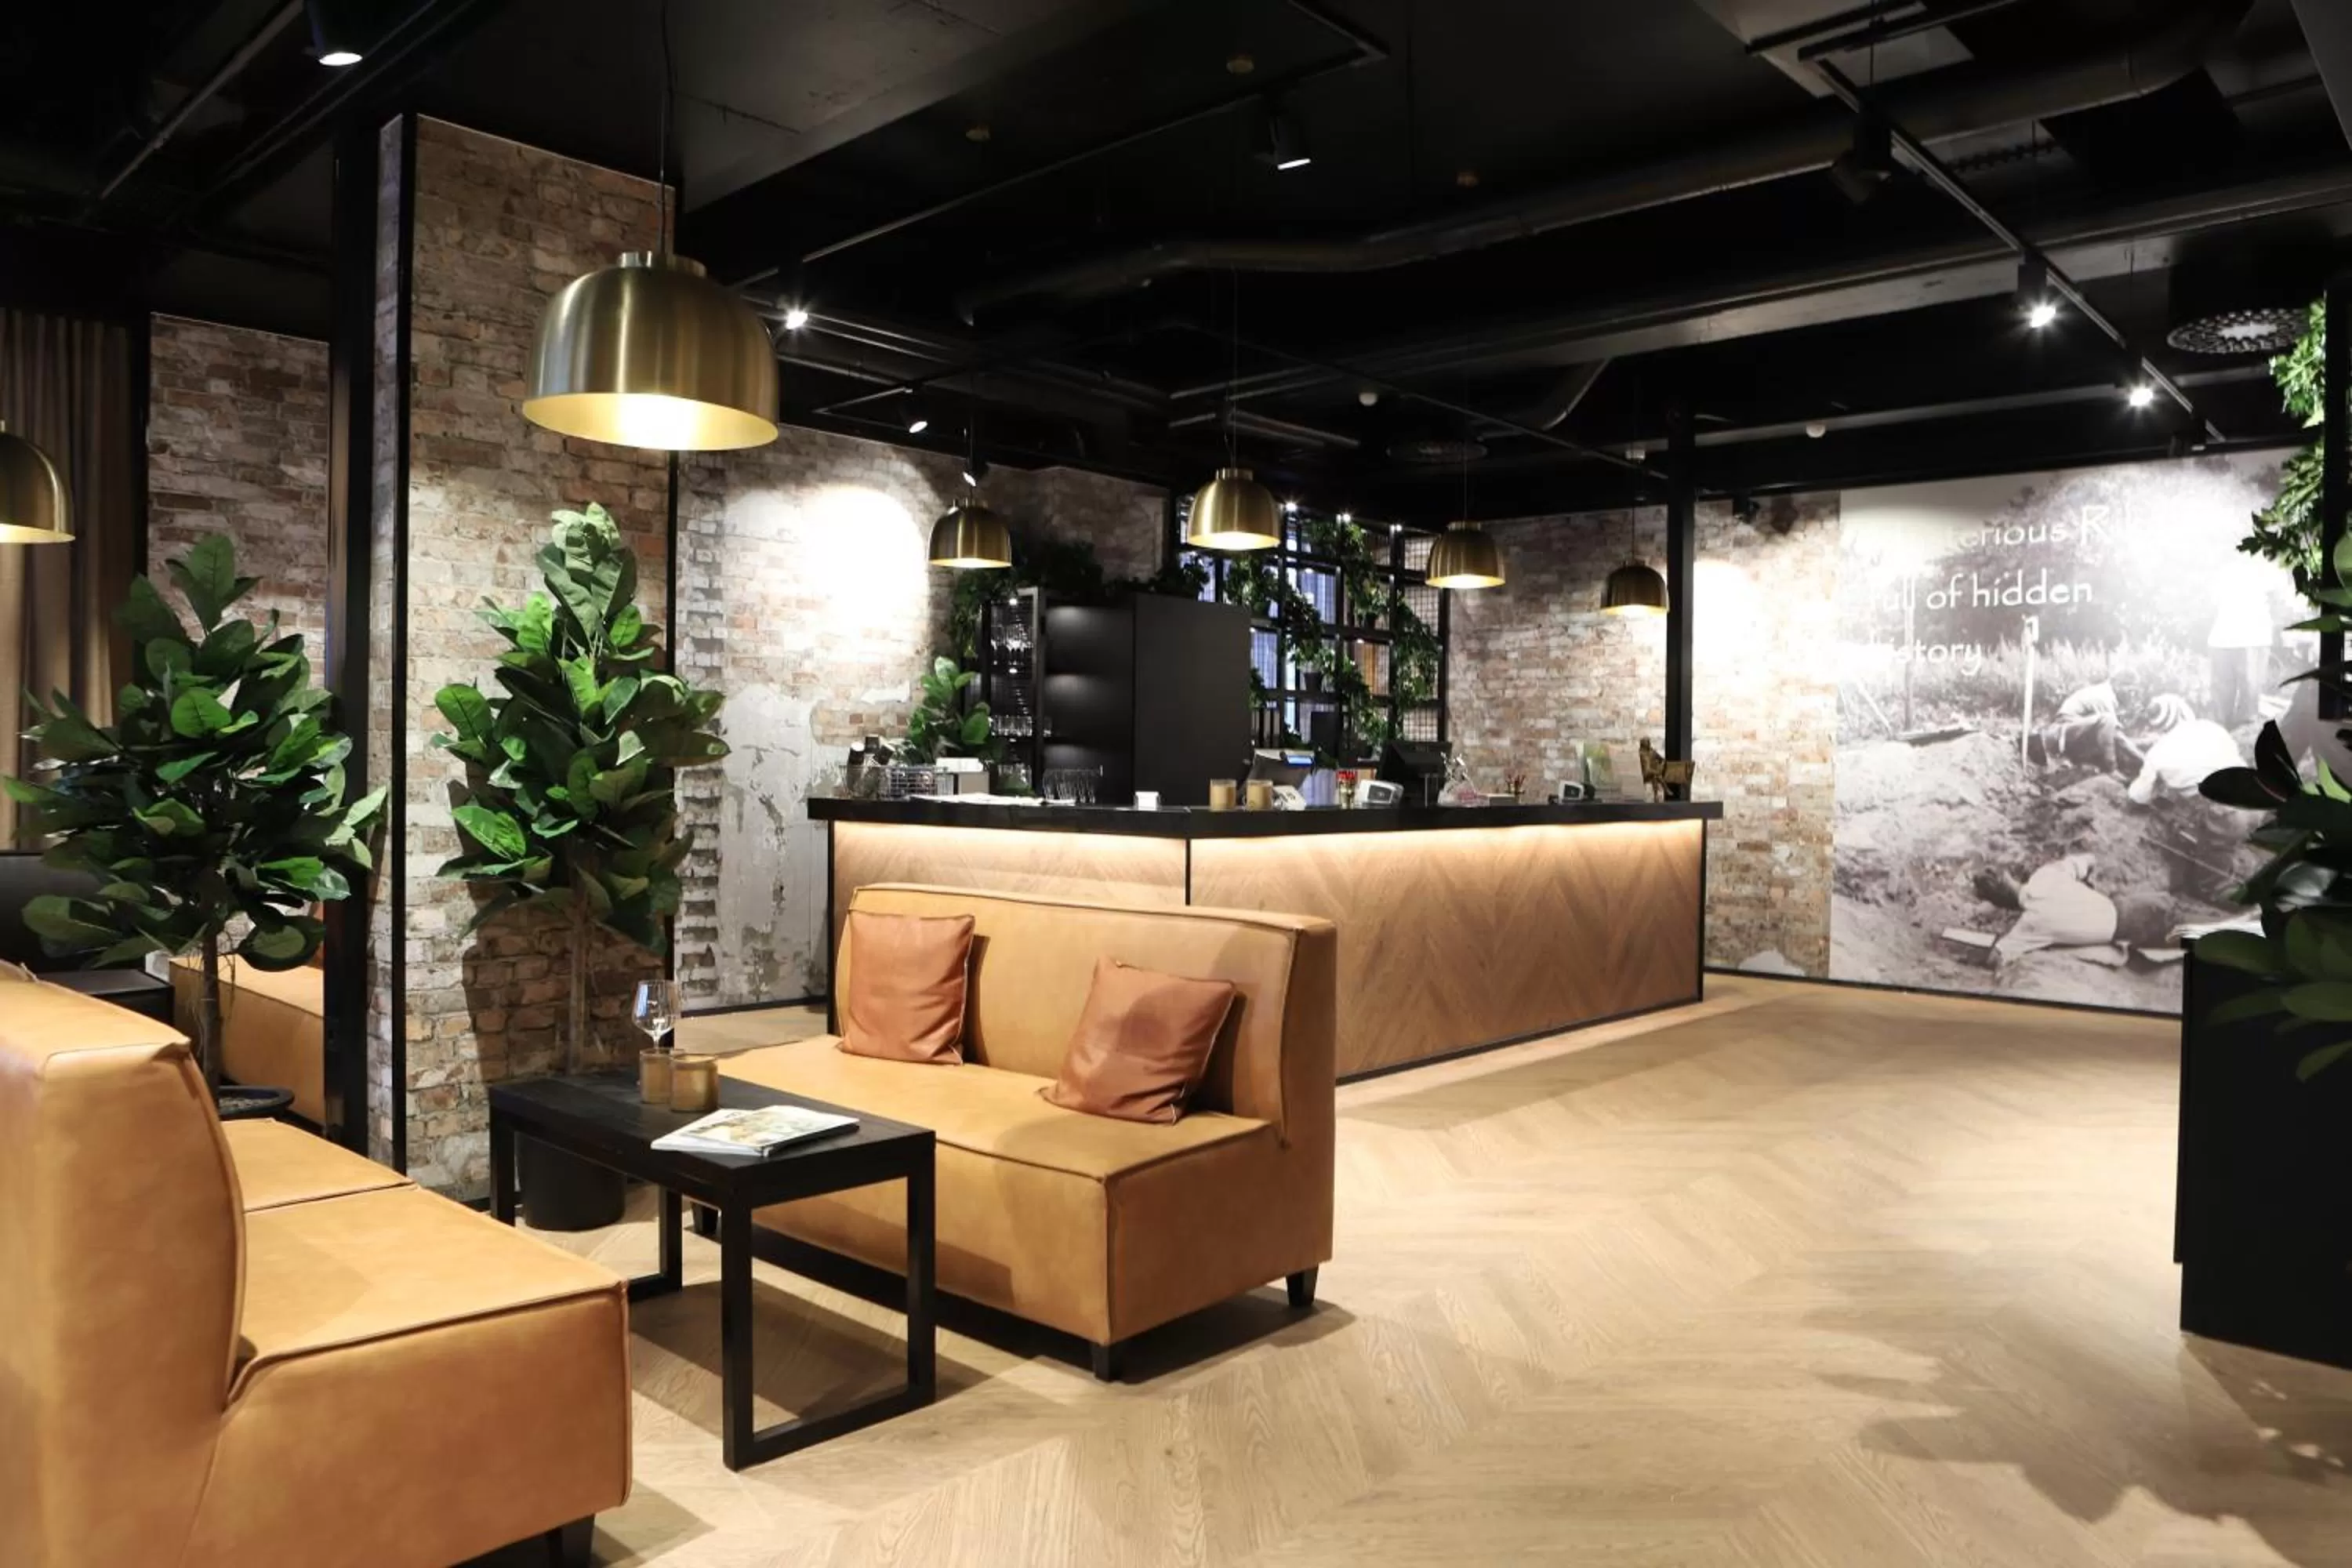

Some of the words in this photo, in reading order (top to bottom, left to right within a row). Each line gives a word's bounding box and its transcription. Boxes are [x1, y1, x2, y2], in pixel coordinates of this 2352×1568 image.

[1926, 572, 1963, 609] of
[1973, 568, 2093, 608] hidden
[1870, 628, 1982, 677] story
